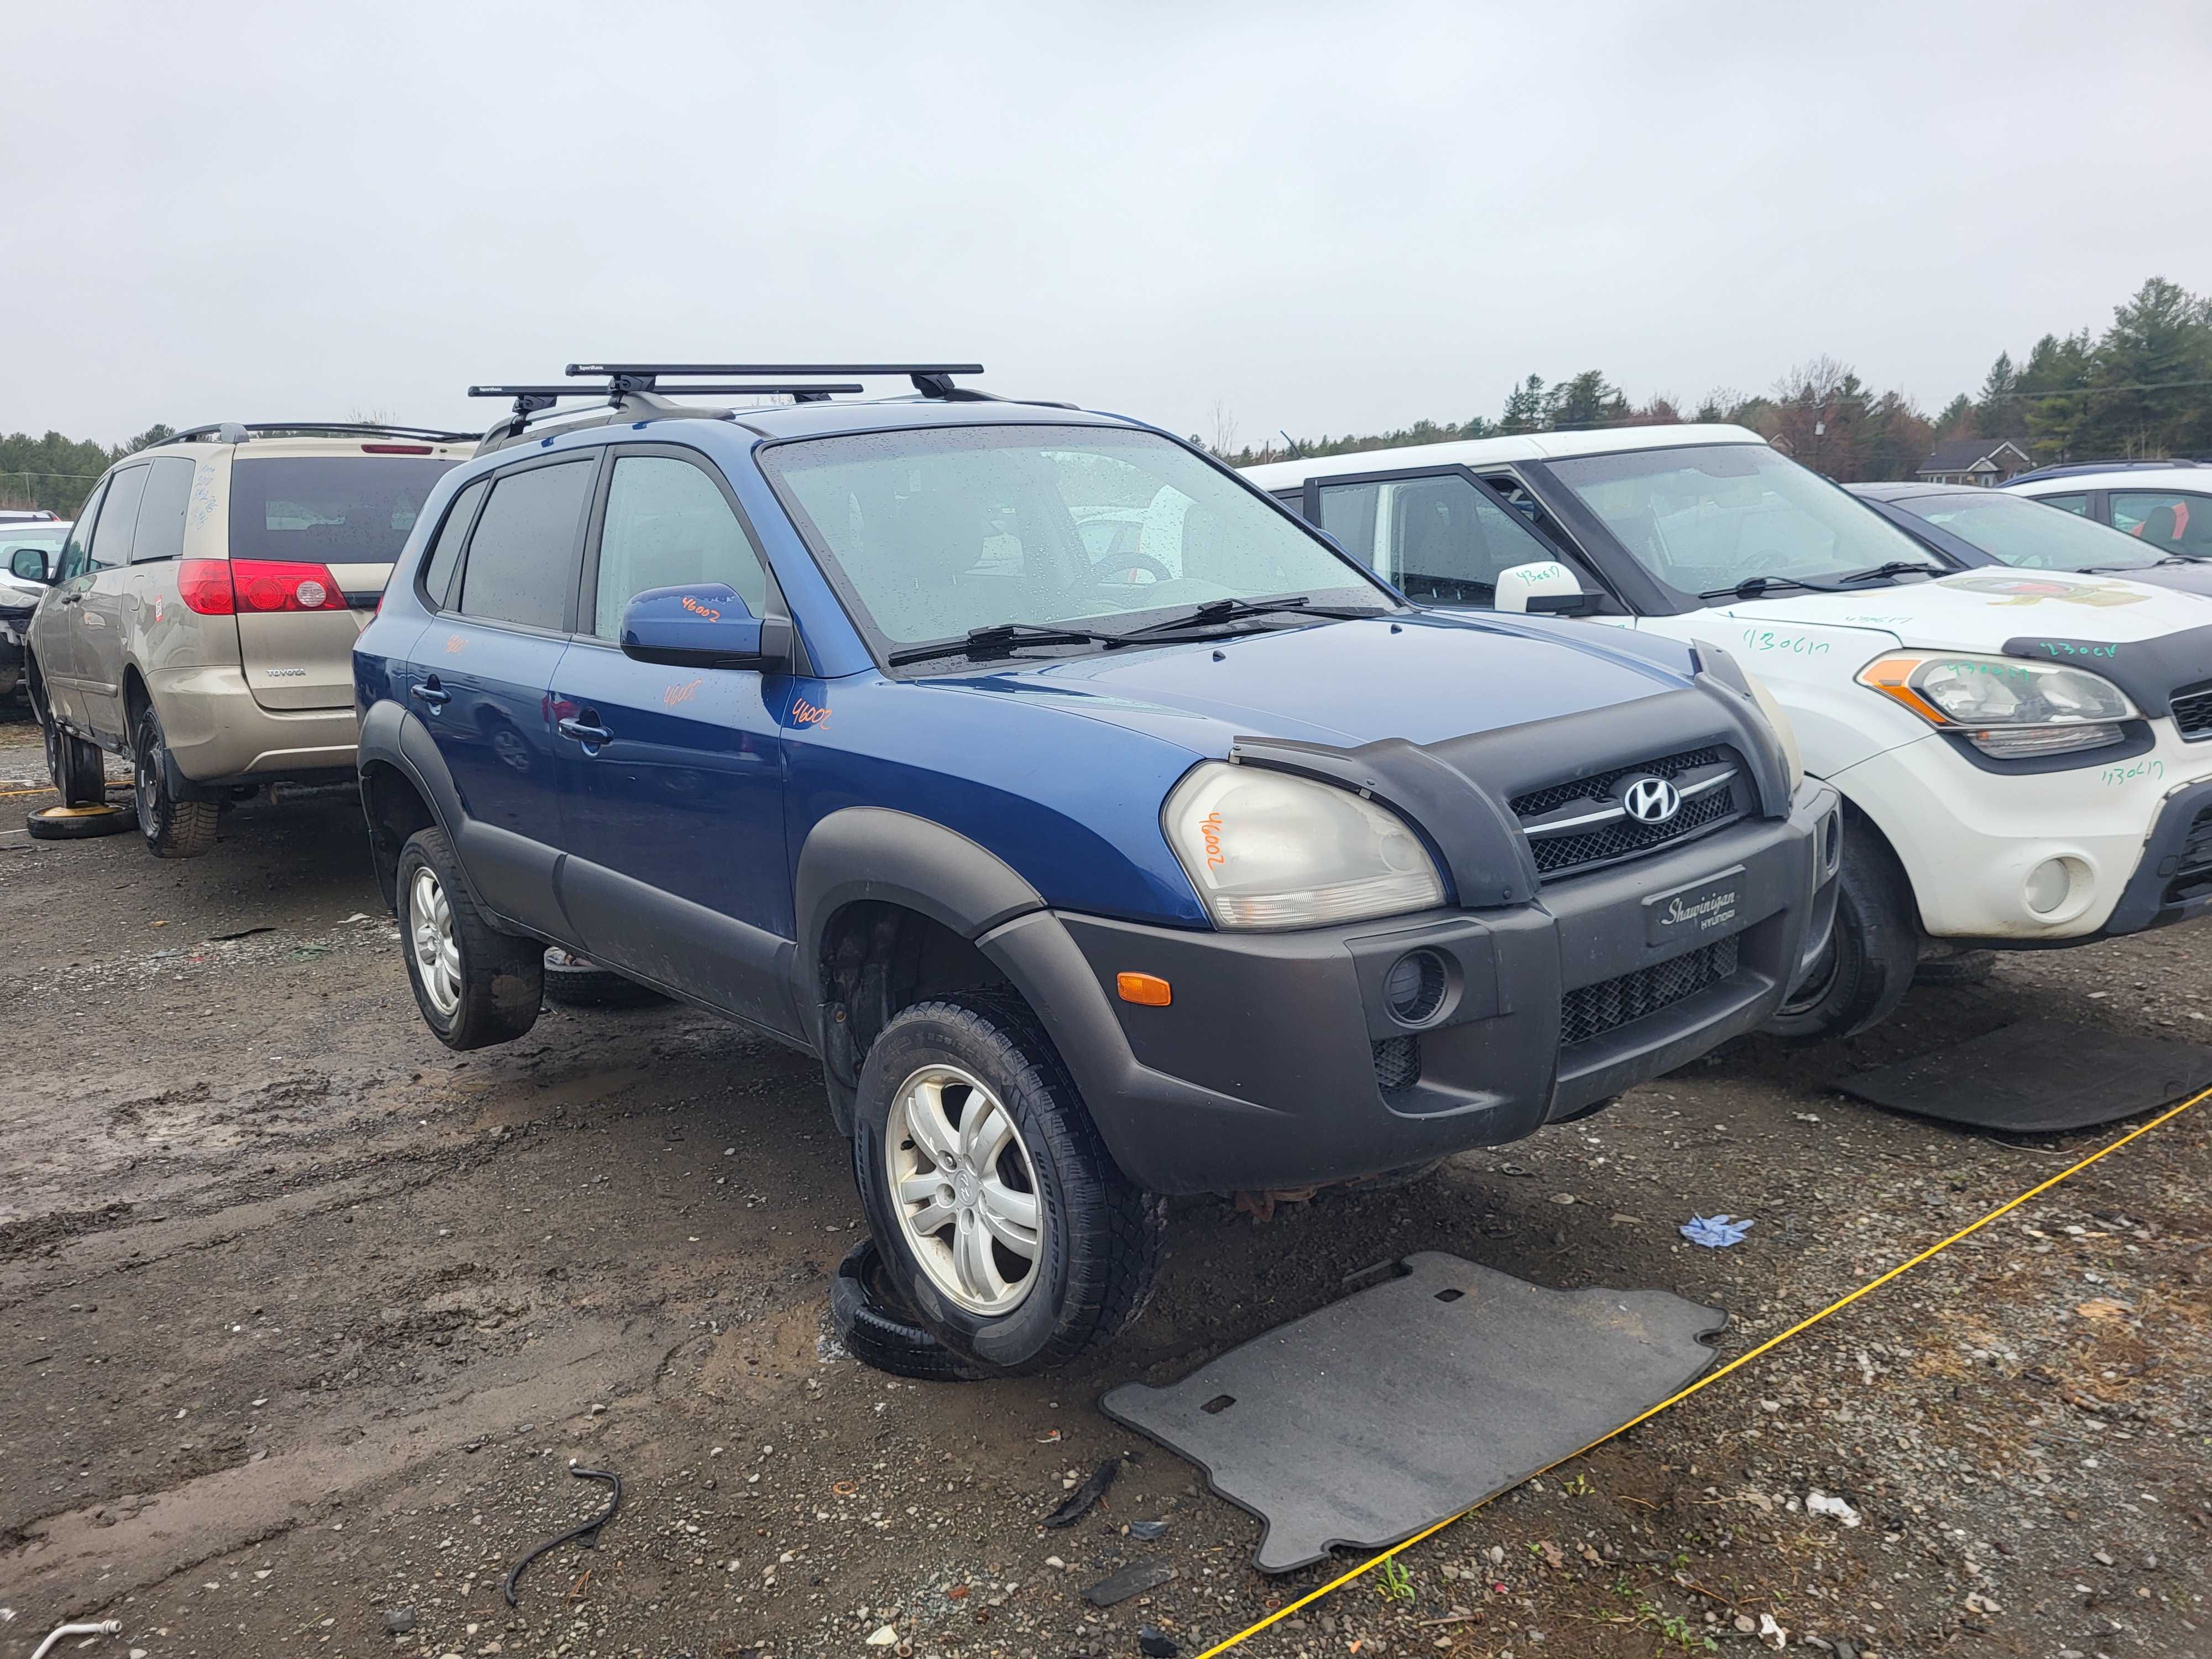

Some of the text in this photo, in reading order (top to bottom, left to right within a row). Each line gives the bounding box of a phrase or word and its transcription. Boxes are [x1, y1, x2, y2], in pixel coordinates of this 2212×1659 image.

[682, 597, 721, 623] 46002
[266, 668, 306, 677] TOYOTA
[791, 697, 831, 730] 46002
[1198, 811, 1225, 872] 46002
[1661, 891, 1736, 925] Shawinigan
